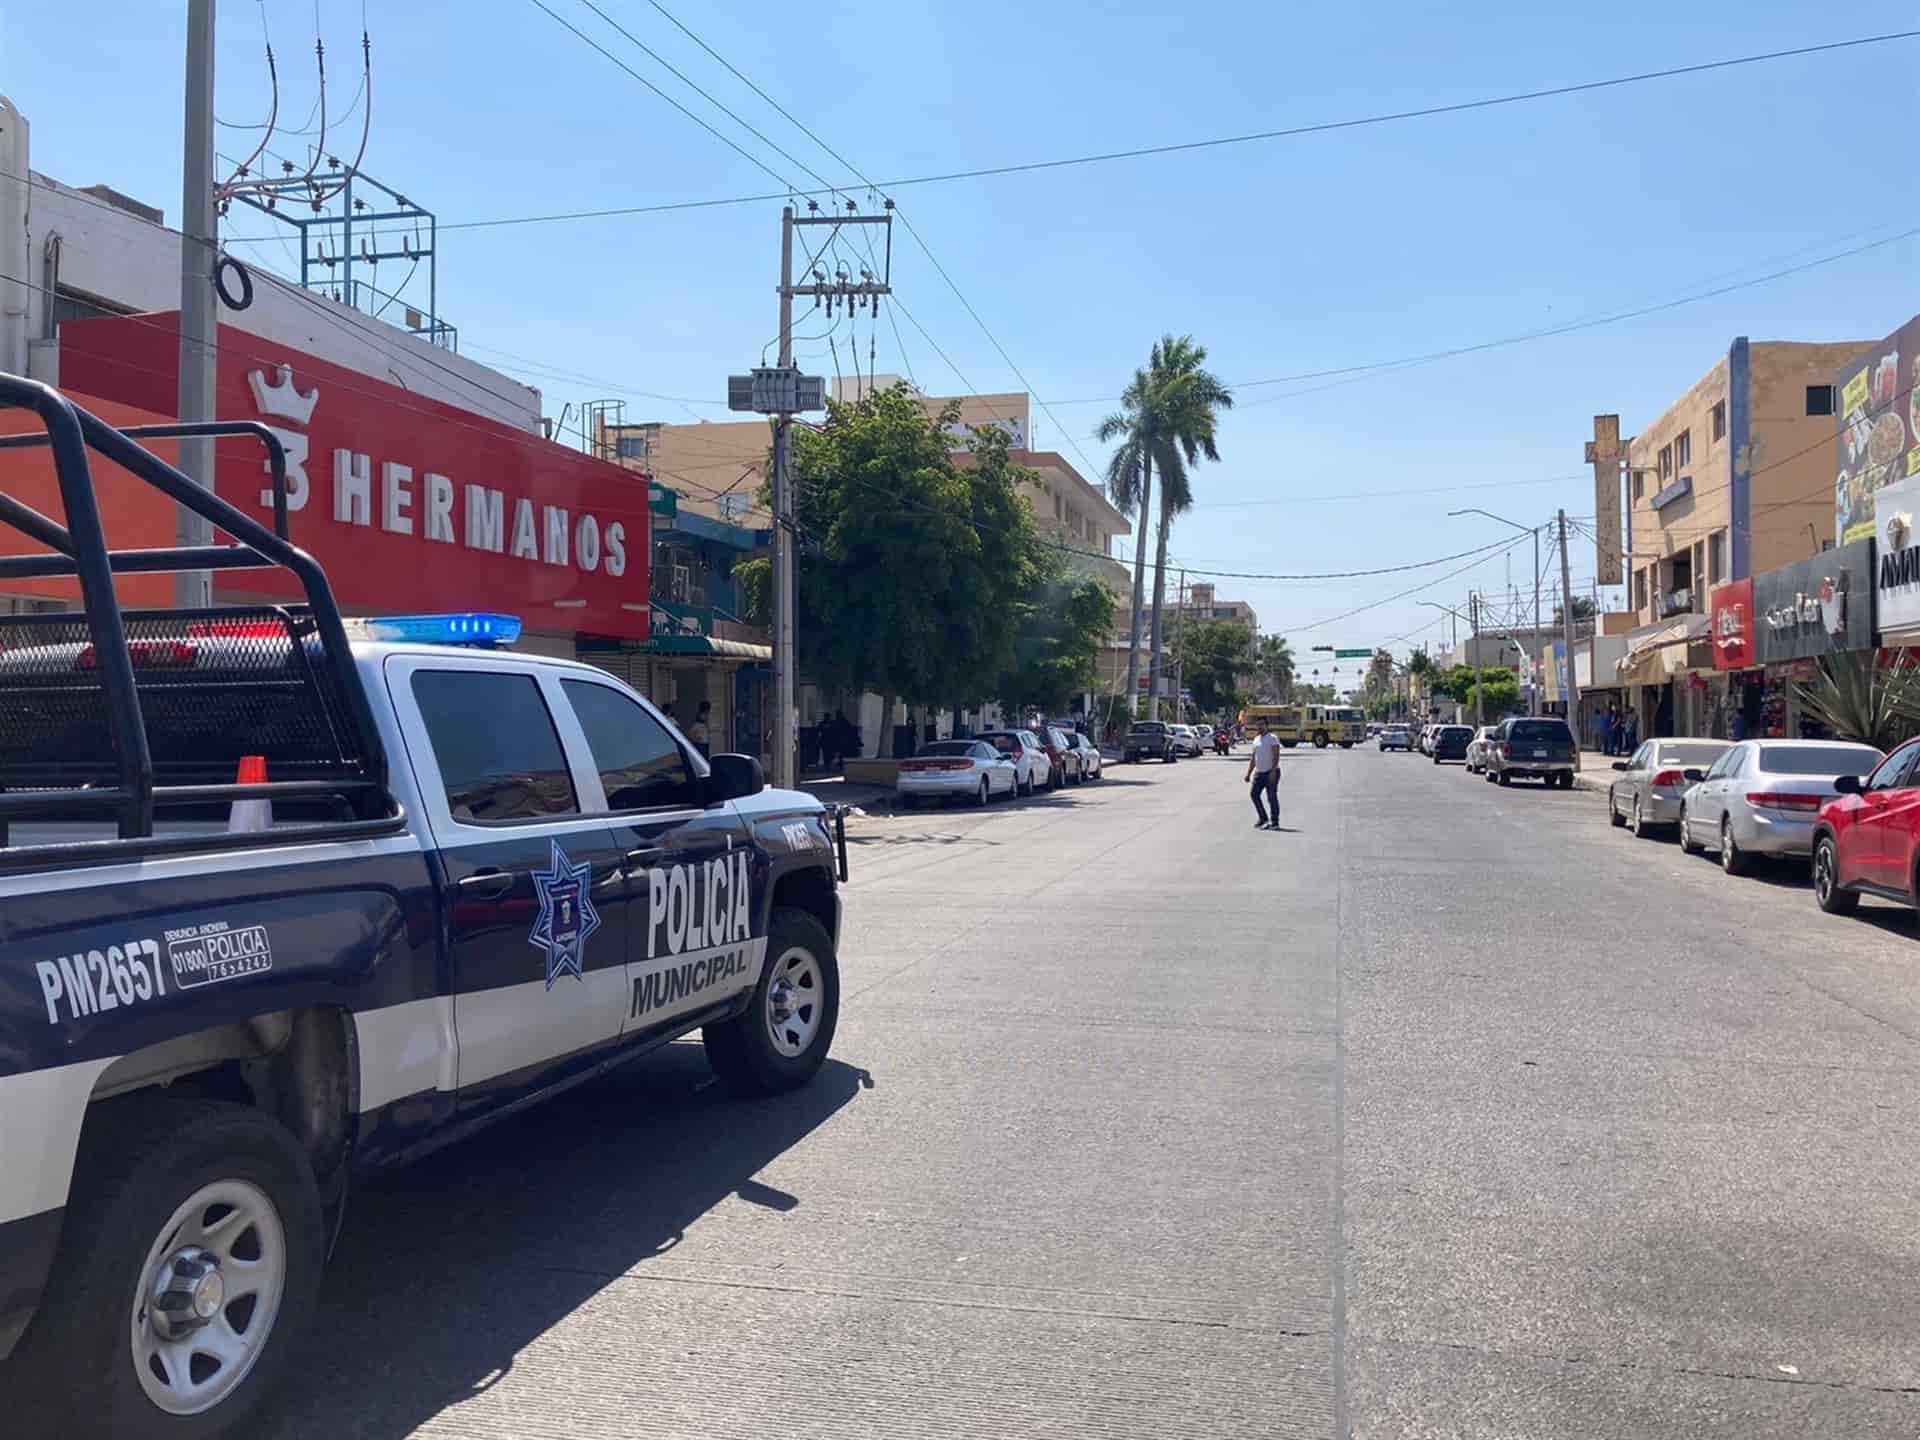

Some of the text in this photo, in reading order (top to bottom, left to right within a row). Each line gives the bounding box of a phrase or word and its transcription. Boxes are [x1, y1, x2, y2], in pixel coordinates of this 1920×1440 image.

[260, 426, 625, 577] 3 HERMANOS
[647, 834, 751, 958] POLICÍA
[36, 940, 166, 1024] PM2657
[173, 929, 265, 974] 01800 POLICIA
[631, 949, 746, 1018] MUNICIPAL
